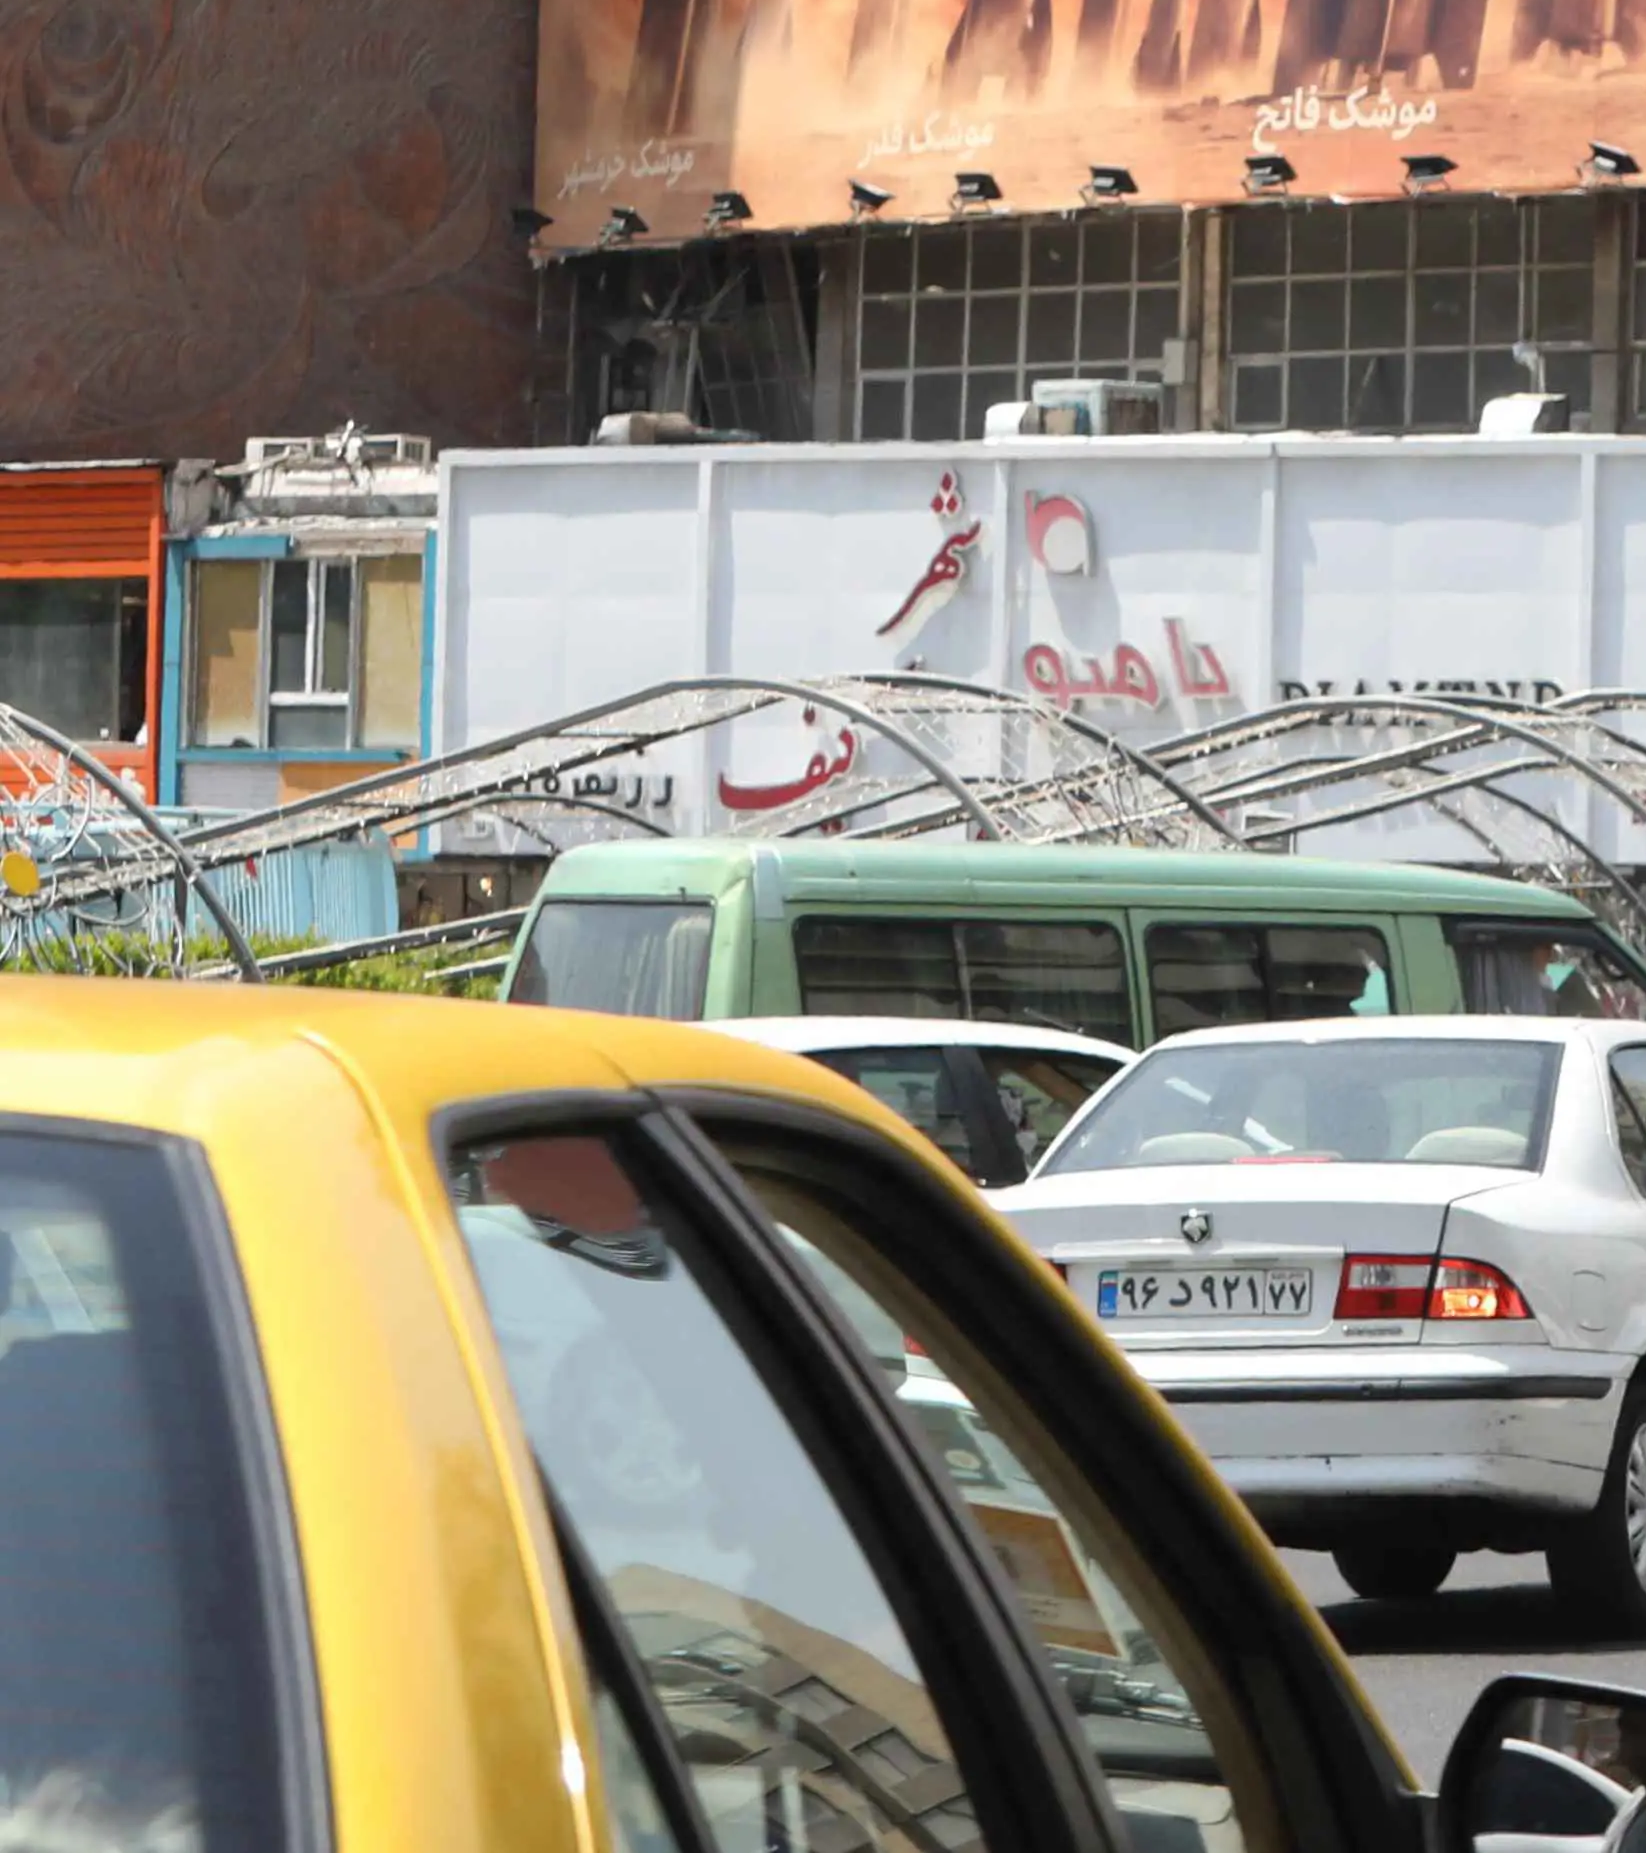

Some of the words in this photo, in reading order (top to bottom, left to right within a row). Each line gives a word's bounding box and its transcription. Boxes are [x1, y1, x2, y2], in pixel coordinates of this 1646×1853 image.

[1252, 84, 1322, 154] فاتح
[1328, 85, 1437, 140] موشک
[875, 468, 982, 637] شهر
[1278, 680, 1564, 726] DIAMD
[1268, 1281, 1308, 1311] ۷۷
